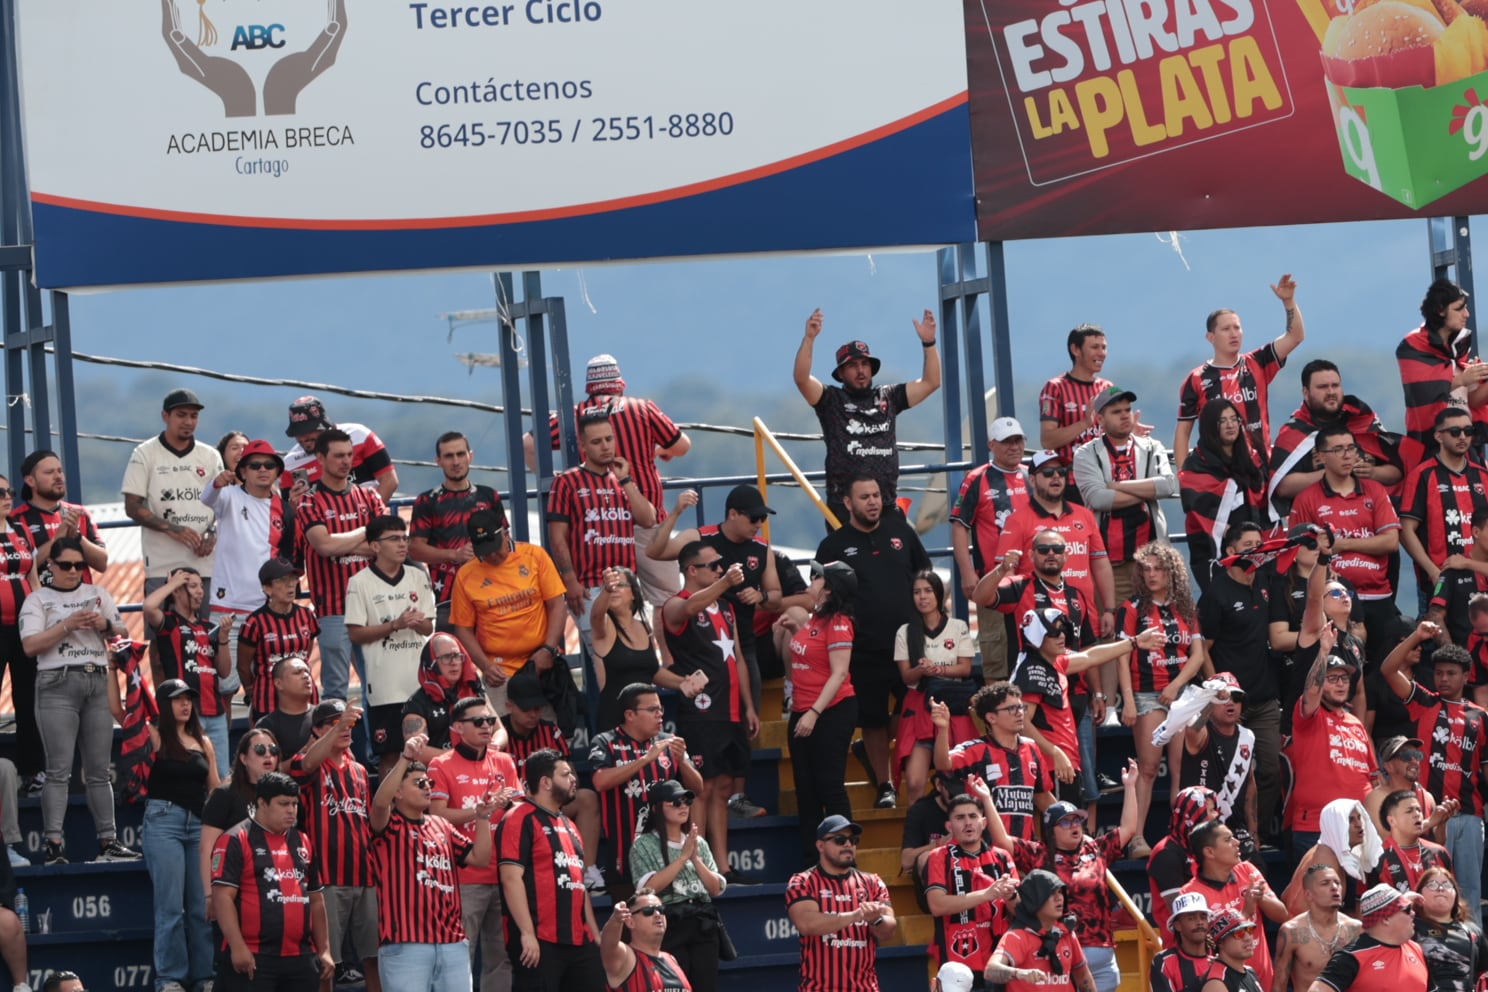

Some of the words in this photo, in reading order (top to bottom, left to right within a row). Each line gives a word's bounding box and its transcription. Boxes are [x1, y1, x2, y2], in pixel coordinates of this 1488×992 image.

[410, 2, 514, 29] Tercer
[525, 0, 602, 24] Ciclo
[230, 23, 286, 51] ABC
[1003, 0, 1256, 93] ESTIRAS
[415, 77, 593, 105] Contáctenos
[1023, 88, 1080, 140] LA
[1075, 35, 1283, 159] PLATA
[166, 128, 279, 155] ACADEMIA
[285, 125, 355, 149] BRECA
[420, 119, 563, 149] 8645-7035
[571, 119, 582, 143] /
[592, 111, 734, 142] 2551-8880
[235, 156, 289, 178] Cartago
[177, 488, 202, 502] kölb
[1065, 541, 1088, 555] ölbi
[73, 896, 111, 919] 056
[114, 966, 152, 986] 077
